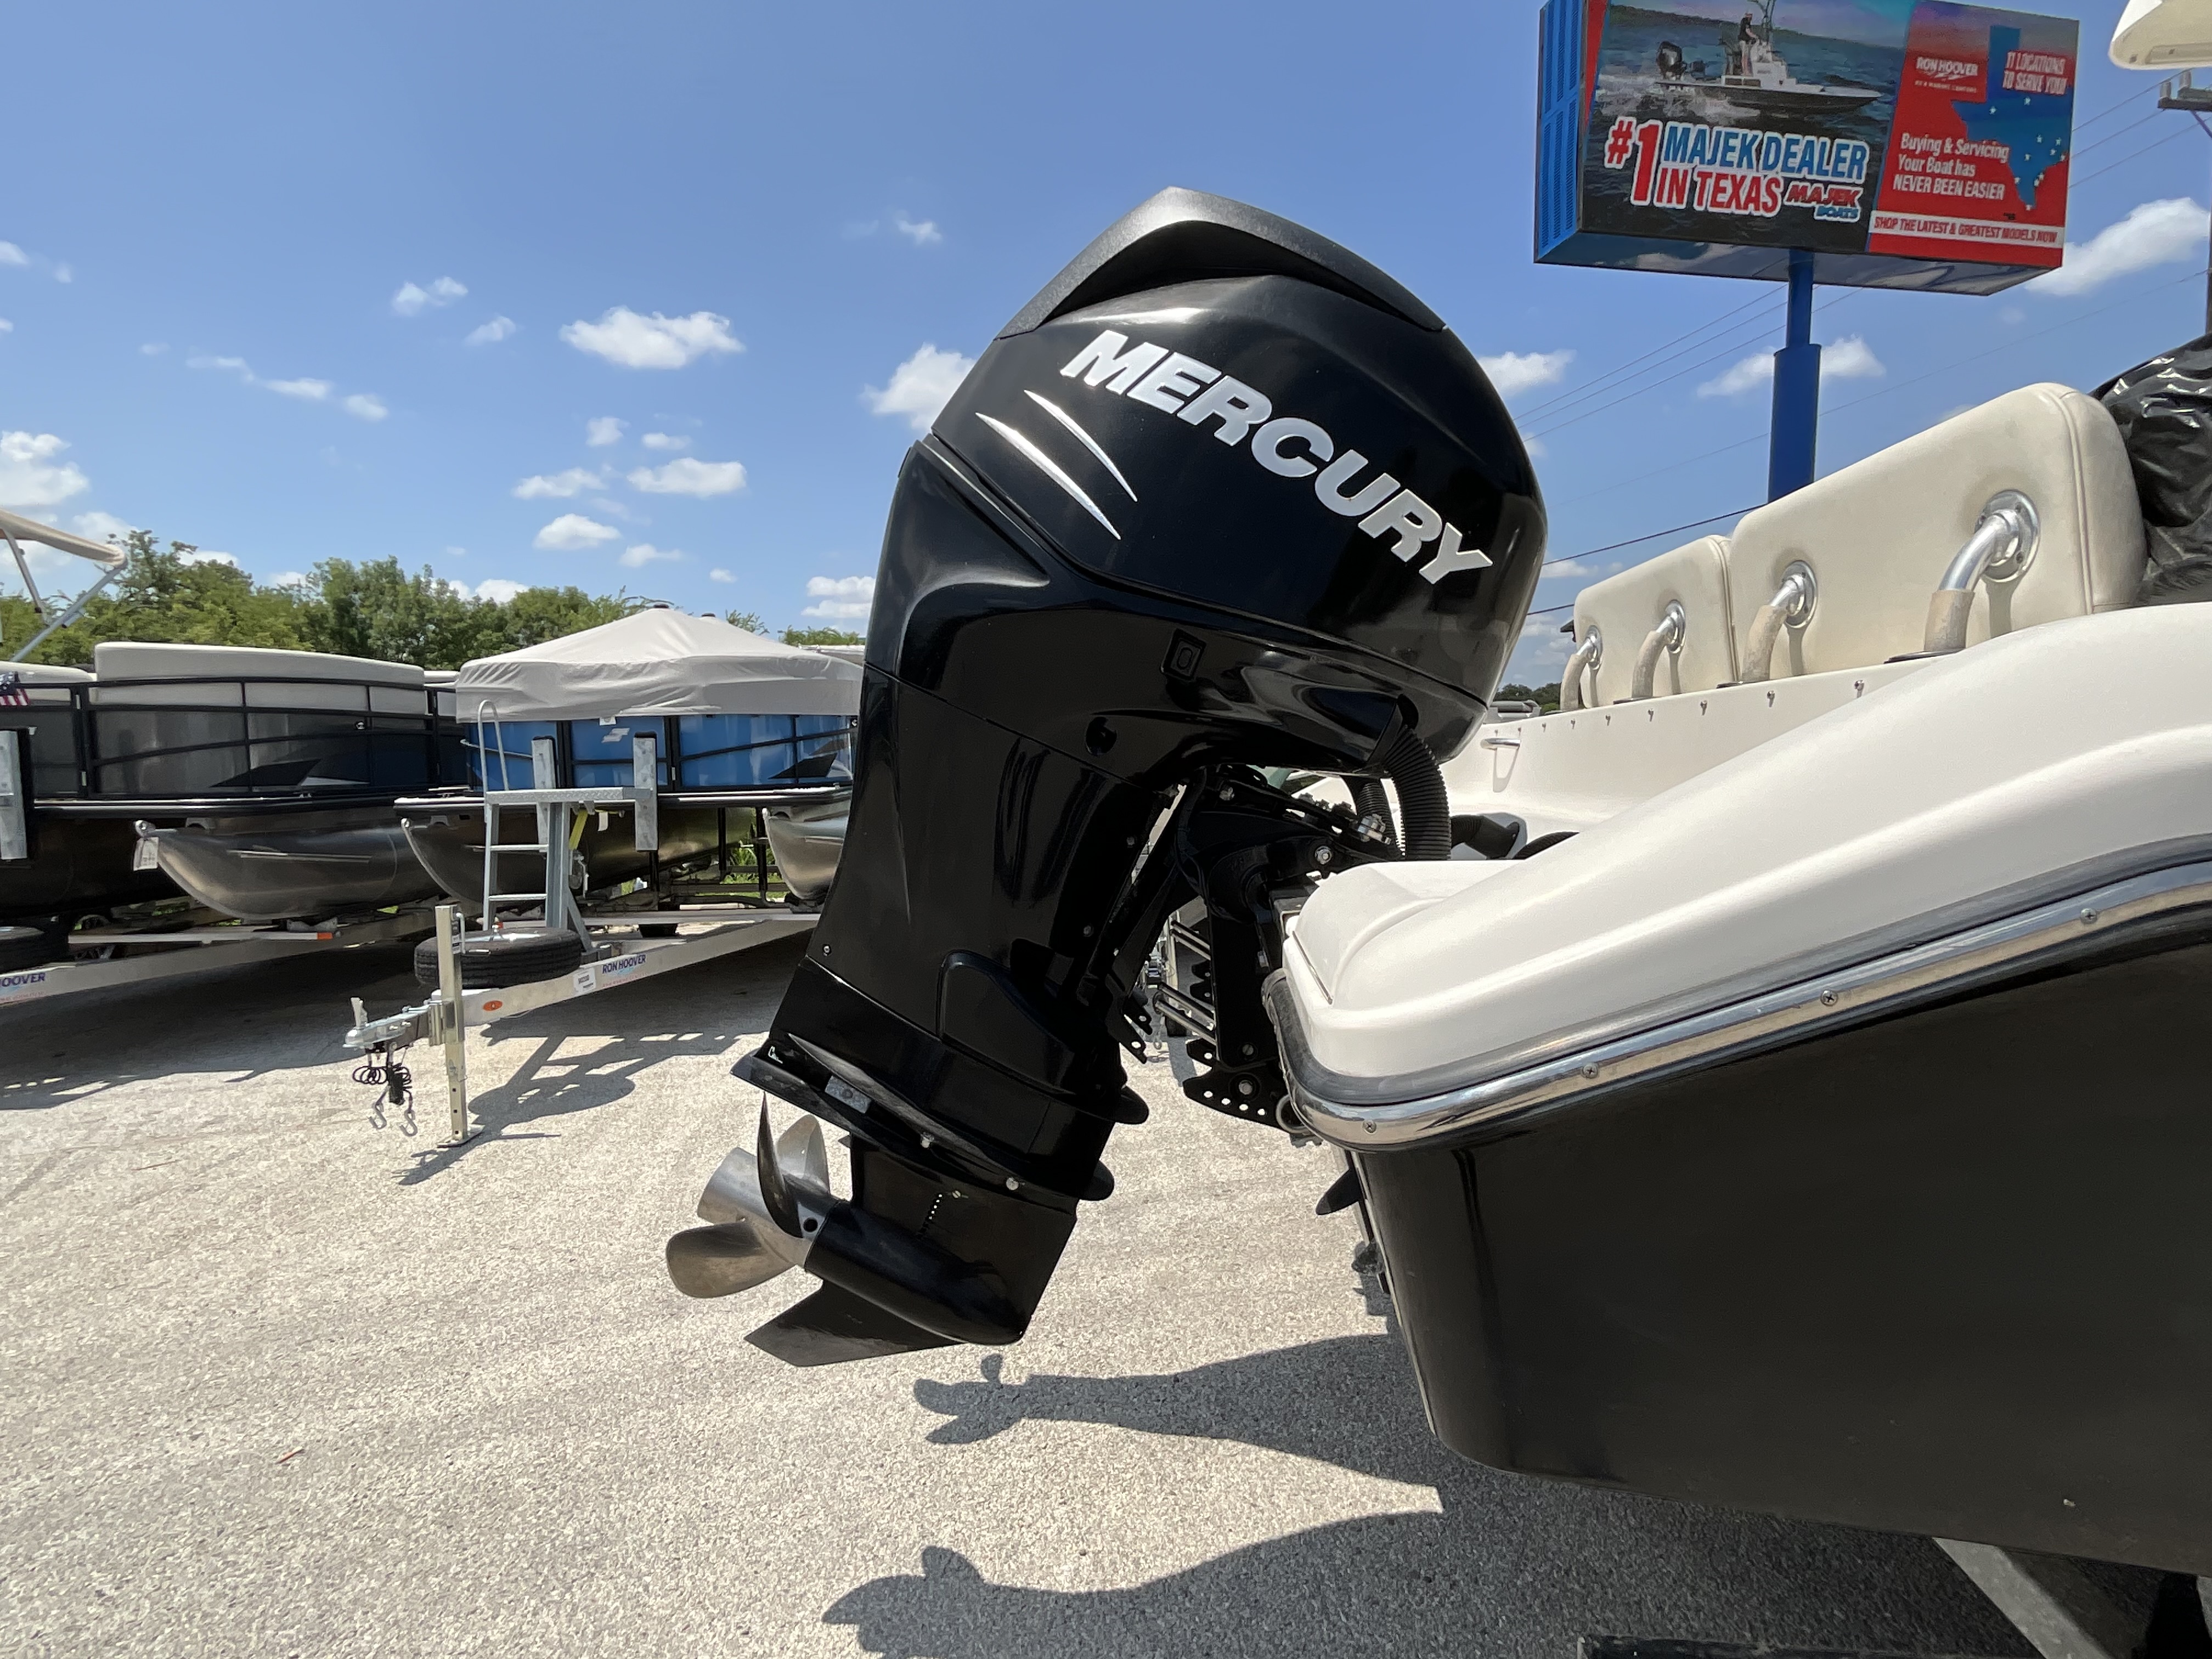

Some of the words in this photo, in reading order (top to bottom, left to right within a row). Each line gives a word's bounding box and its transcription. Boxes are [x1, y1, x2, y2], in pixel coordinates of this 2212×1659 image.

[1916, 57, 1937, 72] RON
[1938, 59, 1978, 76] HOOVER
[2016, 53, 2066, 75] LOCATIONS
[2003, 70, 2015, 89] TO
[2015, 71, 2044, 92] SERVE
[1663, 125, 1760, 170] MAJEK
[1762, 136, 1867, 179] DEALER
[1900, 132, 1942, 156] Buying
[1944, 138, 1953, 154] &
[1955, 139, 2009, 163] Servicing
[1606, 119, 1660, 201] #1
[1898, 154, 1925, 172] Your
[1926, 156, 1954, 175] Boat
[1954, 159, 1976, 177] has
[1656, 168, 1689, 205] IN
[1696, 170, 1781, 214] TEXAS
[1786, 184, 1862, 207] MAJEK
[1893, 174, 1932, 193] NEVER
[1933, 178, 1963, 196] BEEN
[1965, 180, 2005, 200] EASIER
[1875, 216, 1898, 229] SHOP
[1900, 218, 1915, 232] THE
[1917, 220, 1950, 234] LATEST
[1949, 222, 1956, 235] &
[1959, 224, 2001, 238] GREATEST
[2001, 227, 2036, 241] MODELS
[2036, 230, 2058, 243] NOW
[1059, 329, 1494, 585] MERCURY
[602, 961, 618, 974] RON
[618, 954, 646, 970] HOOVER
[0, 972, 46, 987] OOVER
